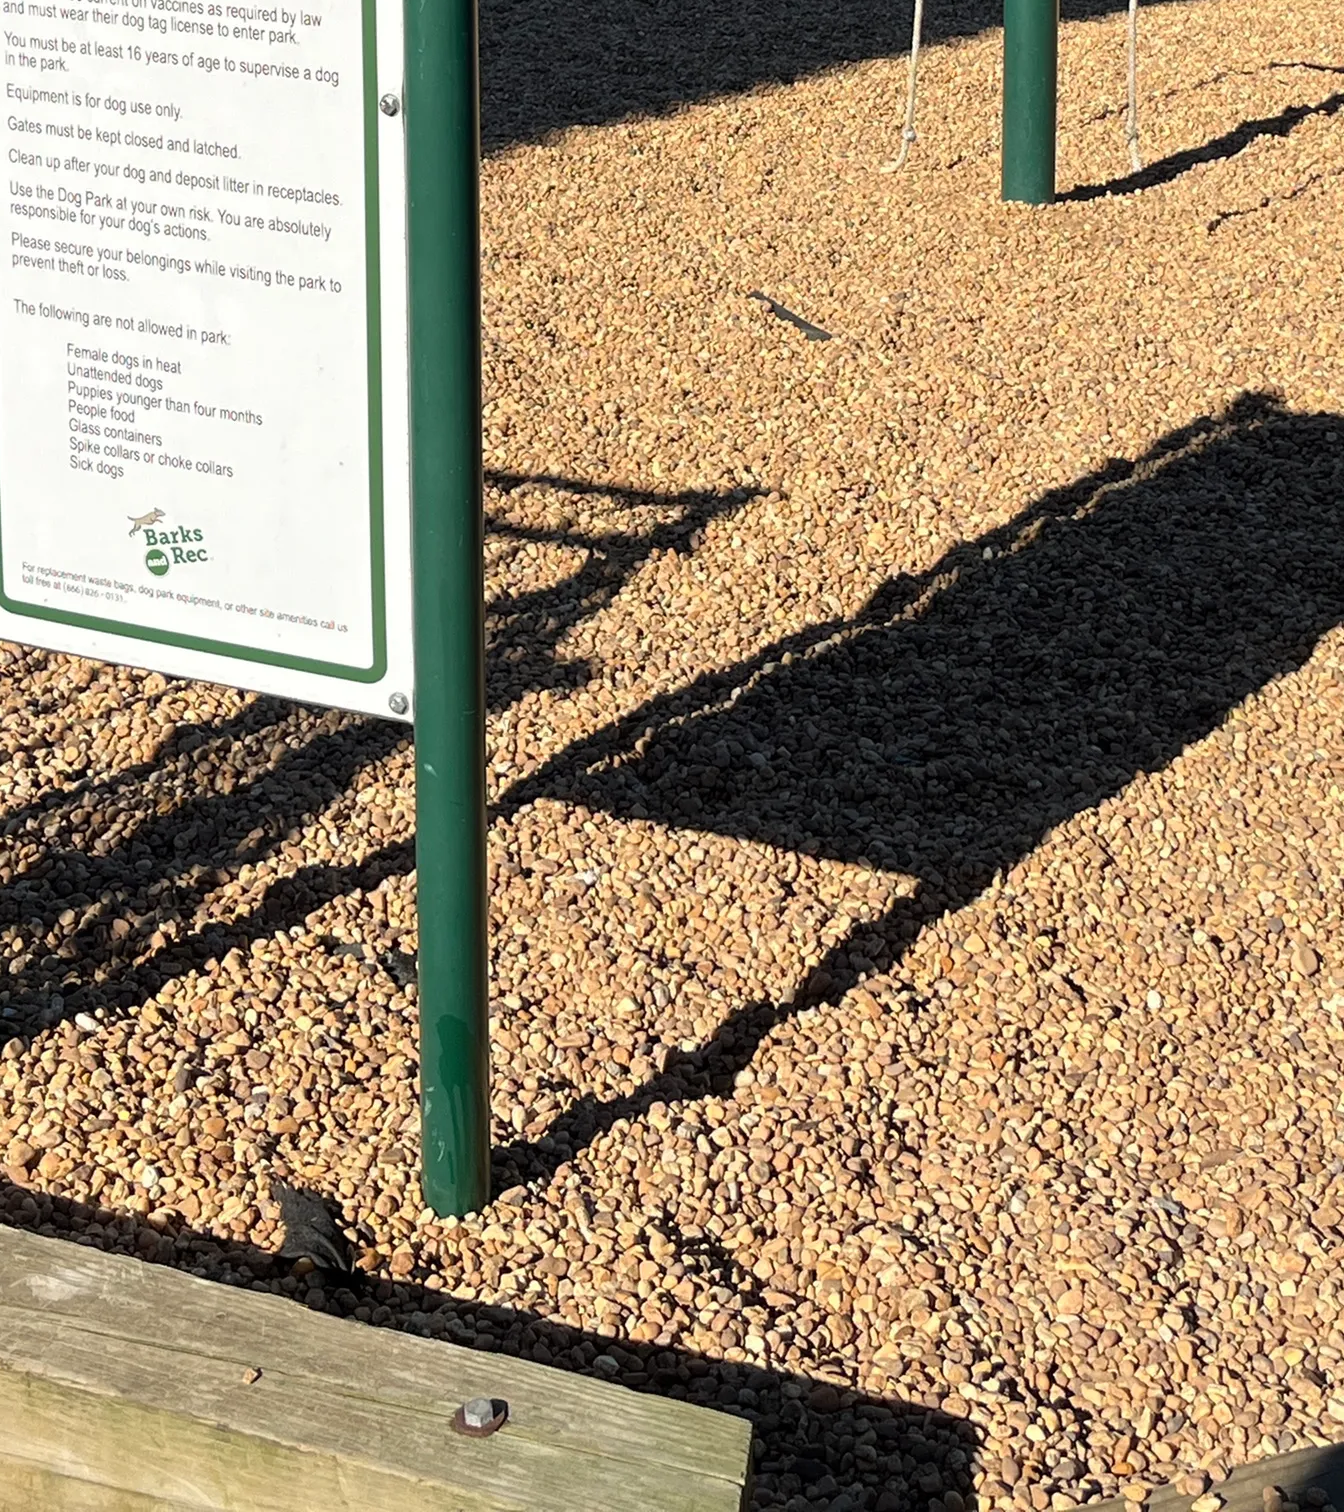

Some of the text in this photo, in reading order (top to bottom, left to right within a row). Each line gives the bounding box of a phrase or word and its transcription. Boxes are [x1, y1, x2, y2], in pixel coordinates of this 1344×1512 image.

[6, 82, 182, 122] Equipment is for dog use only.
[7, 115, 241, 159] Gates must be kept closed and latched.
[8, 147, 343, 206] Clean up after your dog and deposit litter in receptacles.
[9, 179, 331, 242] Use the Dog Park at your own risk. You are absolutely
[12, 297, 35, 315] The
[38, 302, 89, 327] following
[92, 313, 112, 328] are
[115, 316, 134, 331] not
[137, 318, 183, 338] allowed
[186, 324, 197, 340] in
[66, 342, 181, 374] Female dogs in heat
[67, 361, 163, 392] Unattended dogs
[67, 379, 263, 425] Puppies younger than four months
[67, 398, 135, 423] People food
[68, 417, 162, 446] Glass containers
[69, 435, 233, 477] Spike collars or choke collars
[69, 454, 124, 479] Sick dogs
[143, 525, 204, 547] Barks
[147, 546, 209, 569] and Rec
